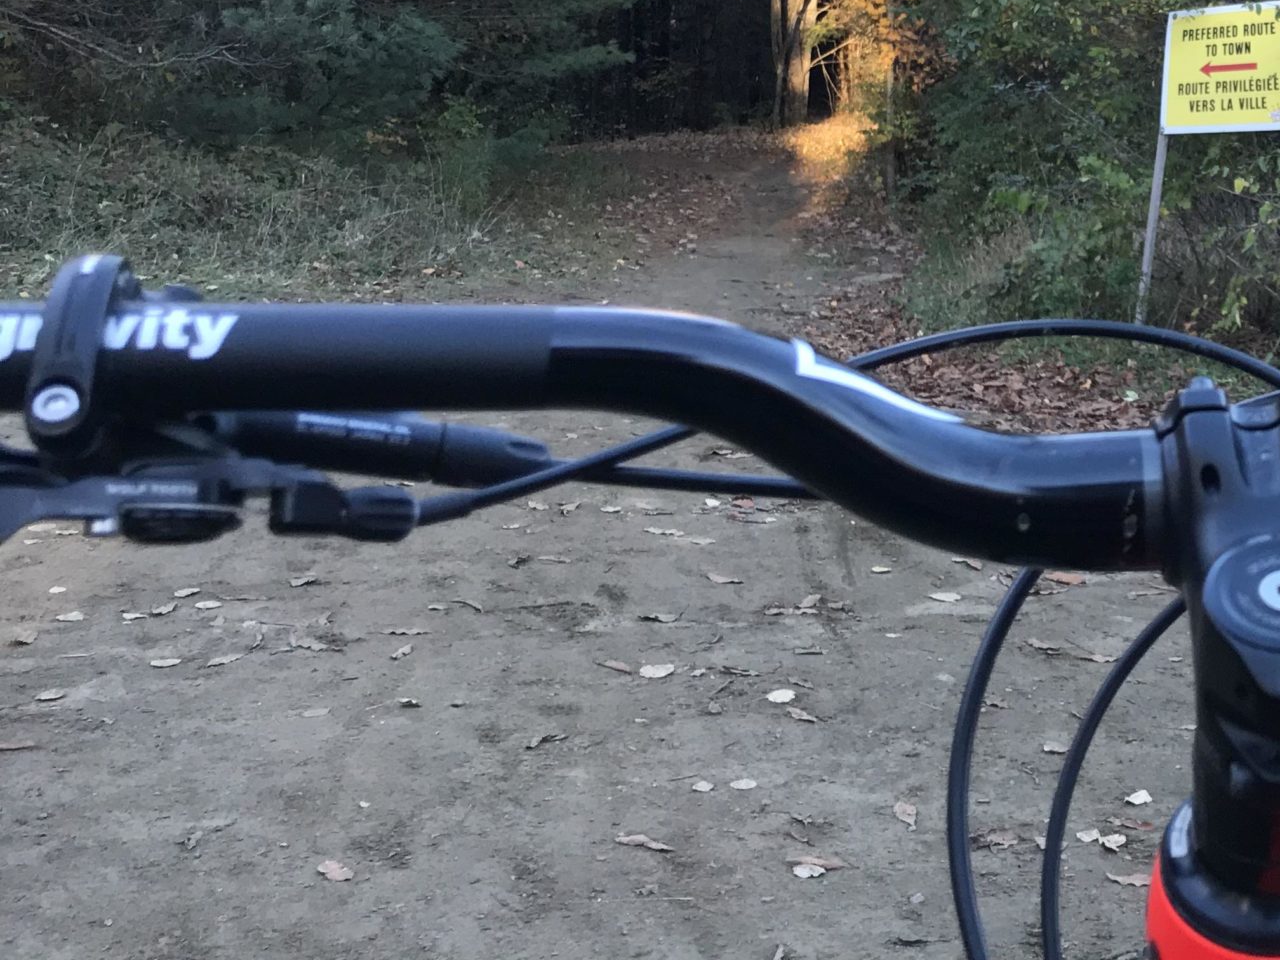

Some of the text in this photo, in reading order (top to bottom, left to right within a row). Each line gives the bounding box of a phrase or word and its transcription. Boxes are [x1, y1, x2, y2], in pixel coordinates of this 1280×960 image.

[1182, 22, 1276, 42] PREFERRED ROUTE
[1205, 42, 1251, 57] TO TOWN
[1178, 82, 1210, 96] ROUTE
[1189, 97, 1267, 112] VERS LA VILLE
